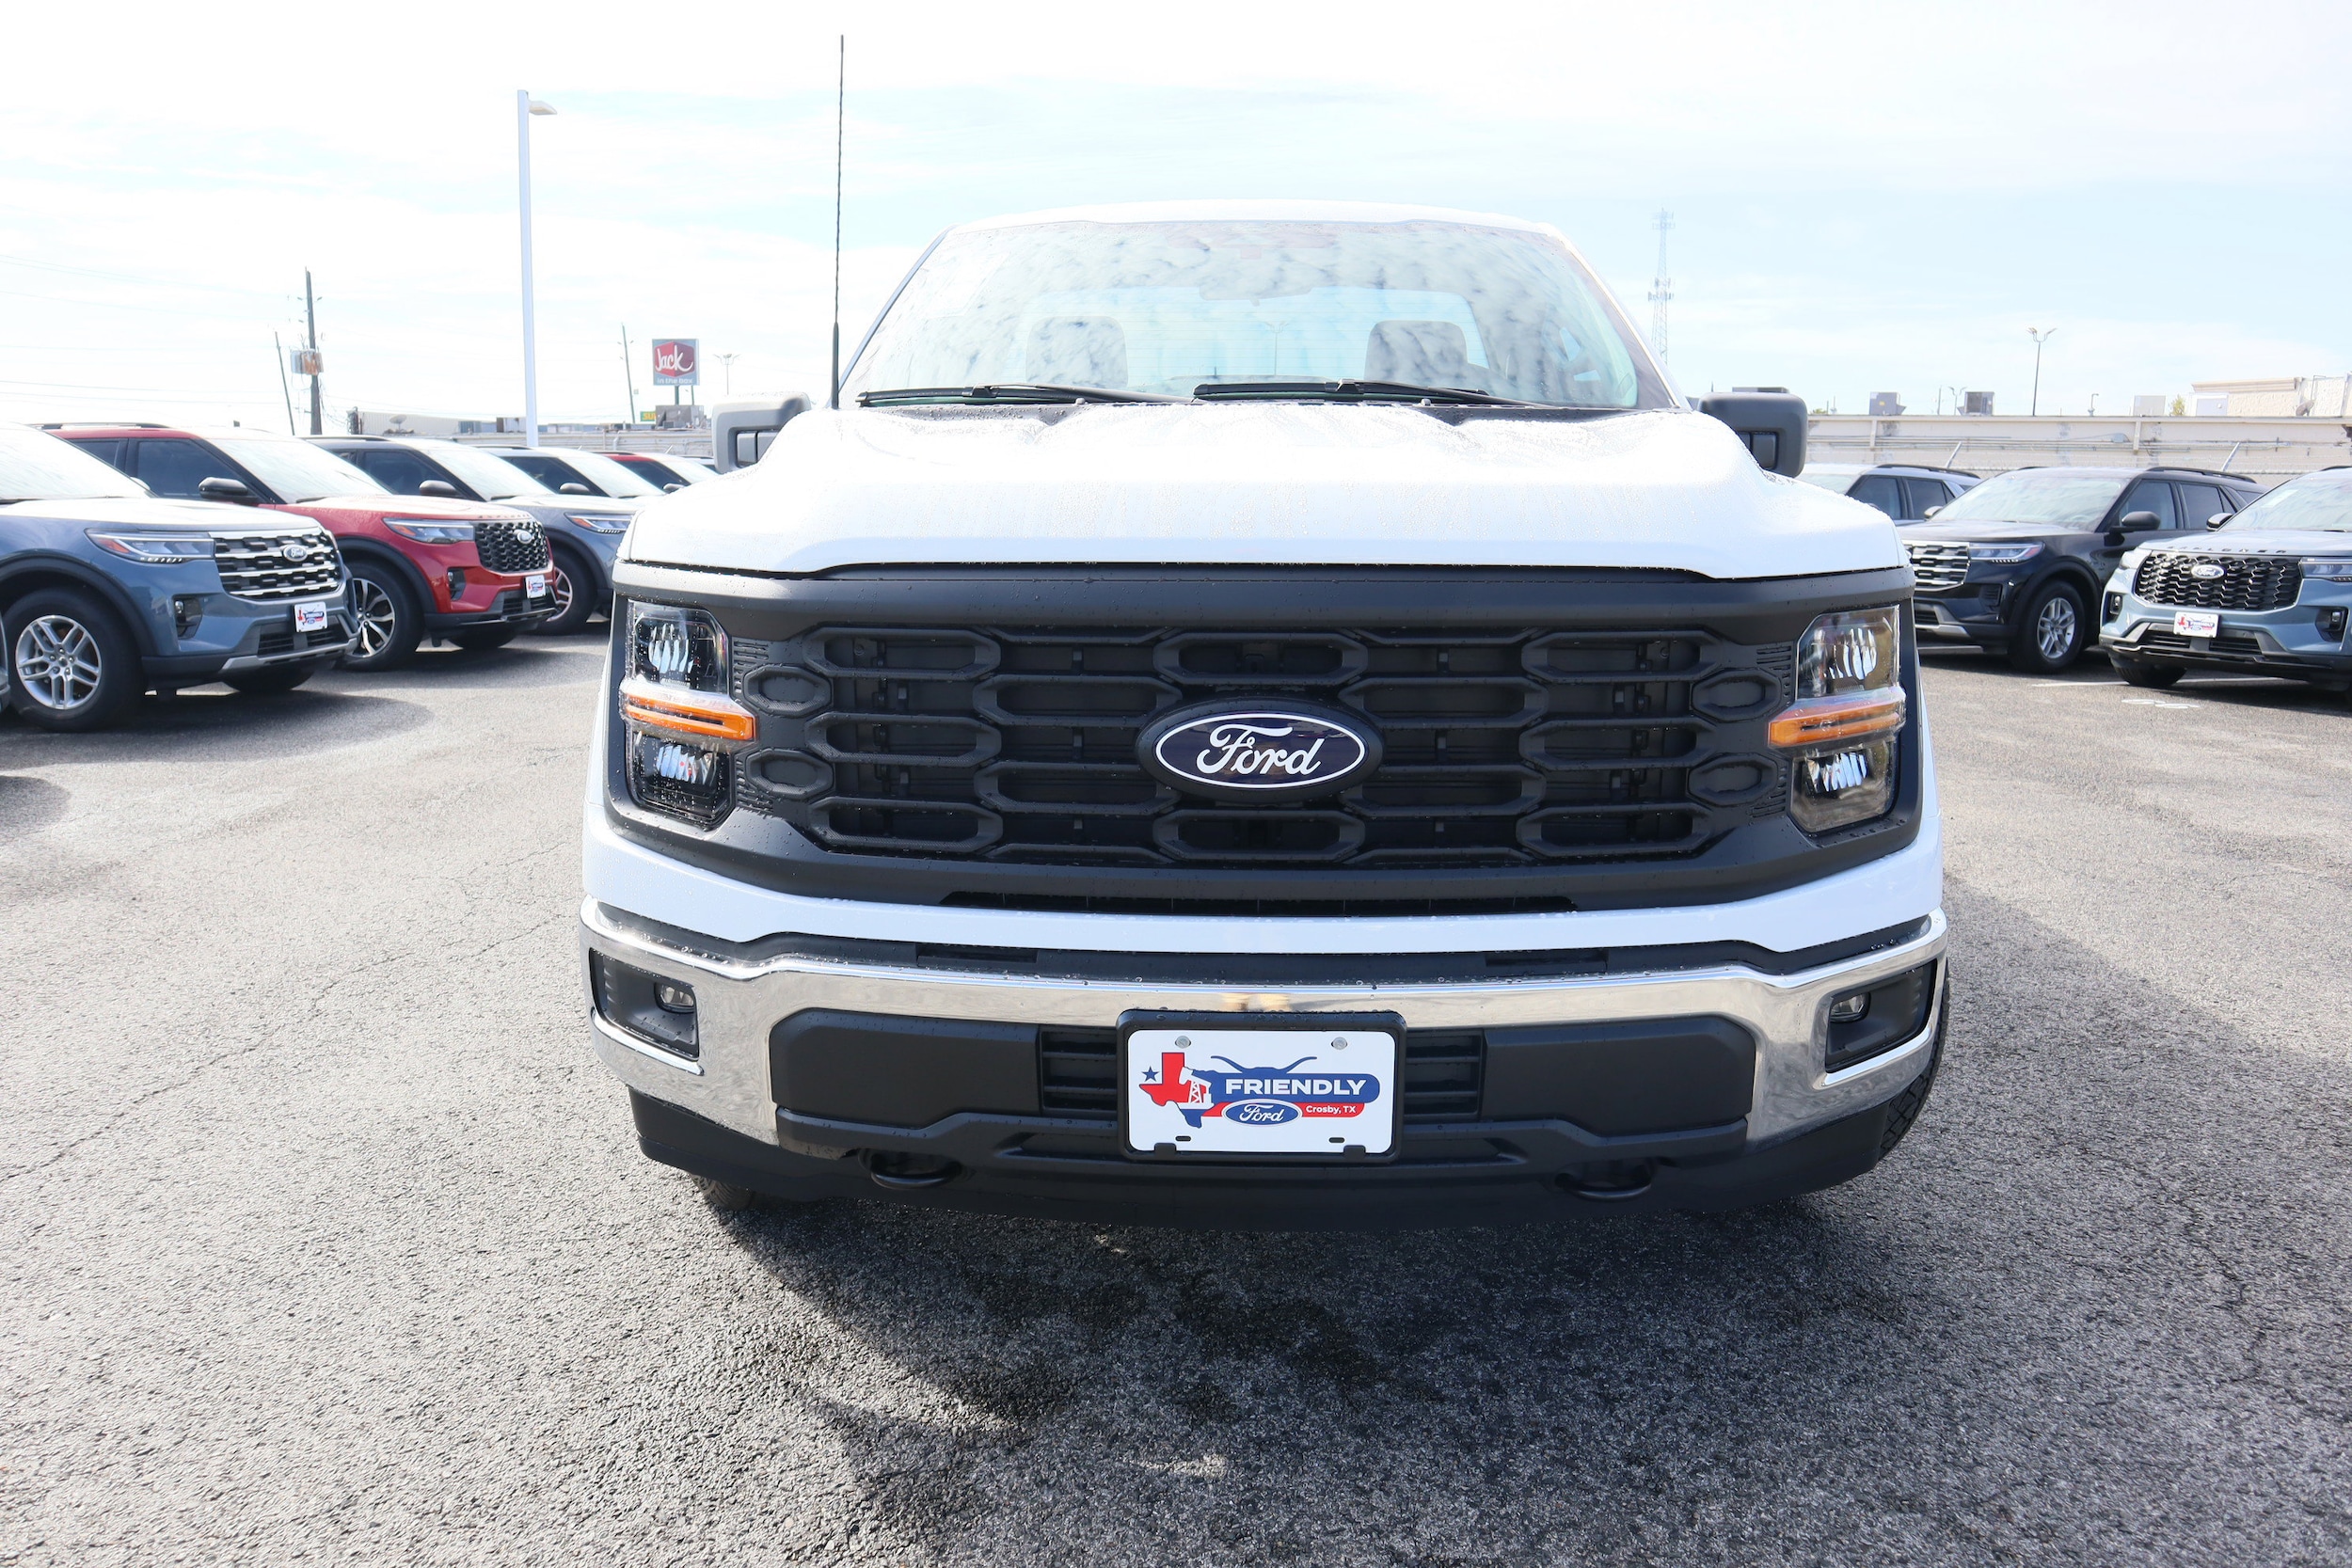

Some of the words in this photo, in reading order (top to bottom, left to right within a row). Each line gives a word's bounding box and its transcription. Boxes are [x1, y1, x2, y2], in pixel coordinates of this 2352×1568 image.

[655, 344, 694, 372] Jack
[1196, 723, 1326, 775] Ford
[1225, 1078, 1367, 1096] FRIENDLY
[1238, 1103, 1285, 1123] Ford
[1305, 1104, 1342, 1115] Crosby,
[1343, 1105, 1357, 1114] TX
